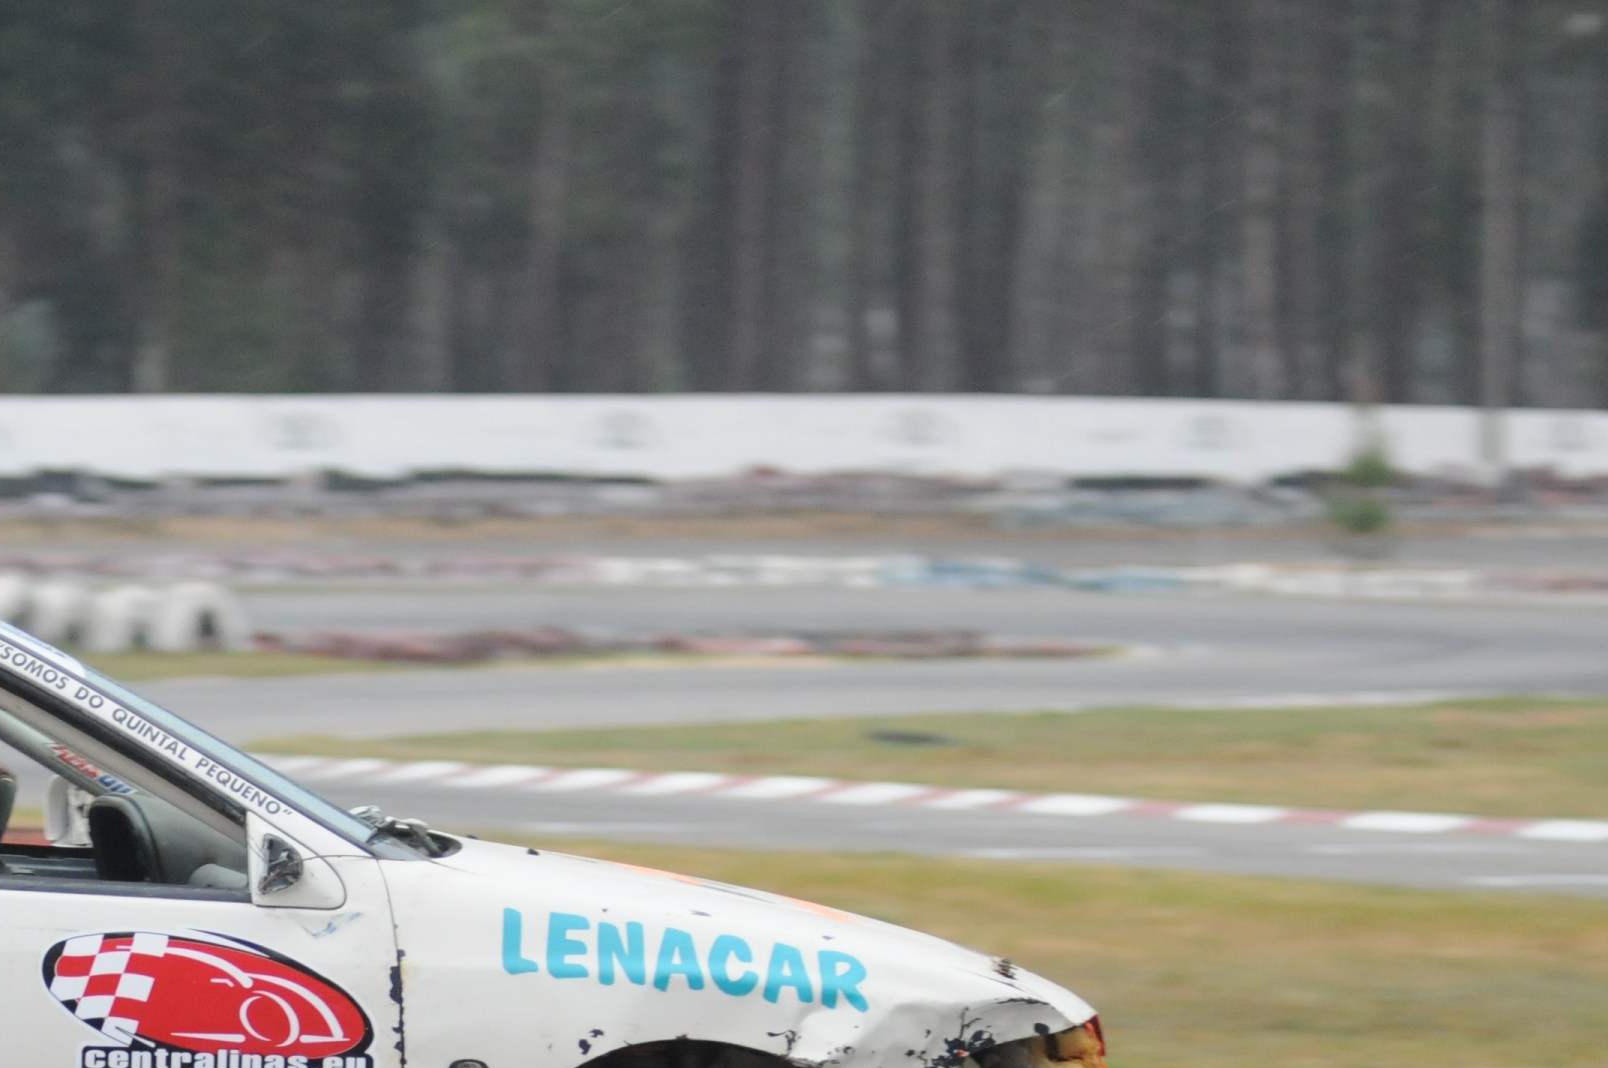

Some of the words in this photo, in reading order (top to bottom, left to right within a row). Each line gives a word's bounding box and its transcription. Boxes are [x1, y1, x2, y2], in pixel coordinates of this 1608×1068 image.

[73, 686, 104, 709] DO
[112, 708, 189, 761] QUINTAL
[501, 907, 870, 1013] LENACAR
